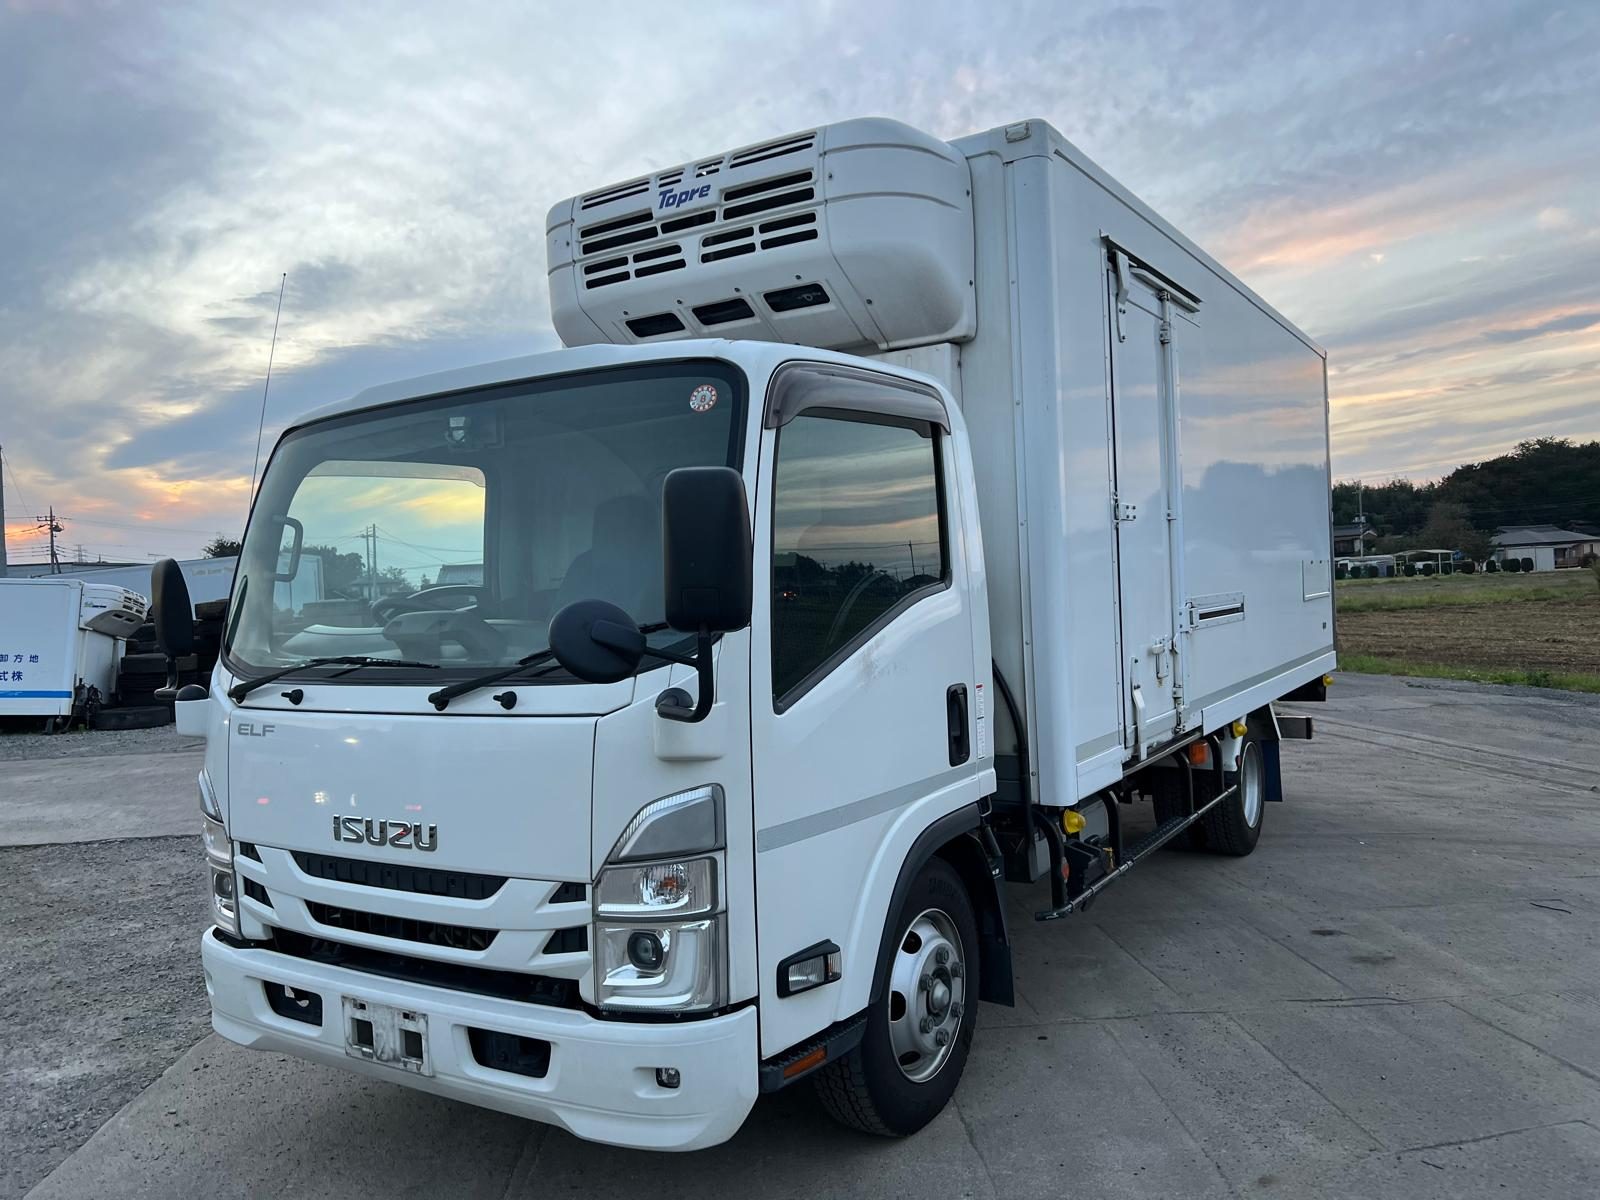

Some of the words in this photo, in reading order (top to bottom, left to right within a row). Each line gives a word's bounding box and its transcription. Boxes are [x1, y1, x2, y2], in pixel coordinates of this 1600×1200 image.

[658, 184, 711, 209] Topre
[237, 723, 275, 737] ELF
[333, 814, 438, 852] ISUZU
